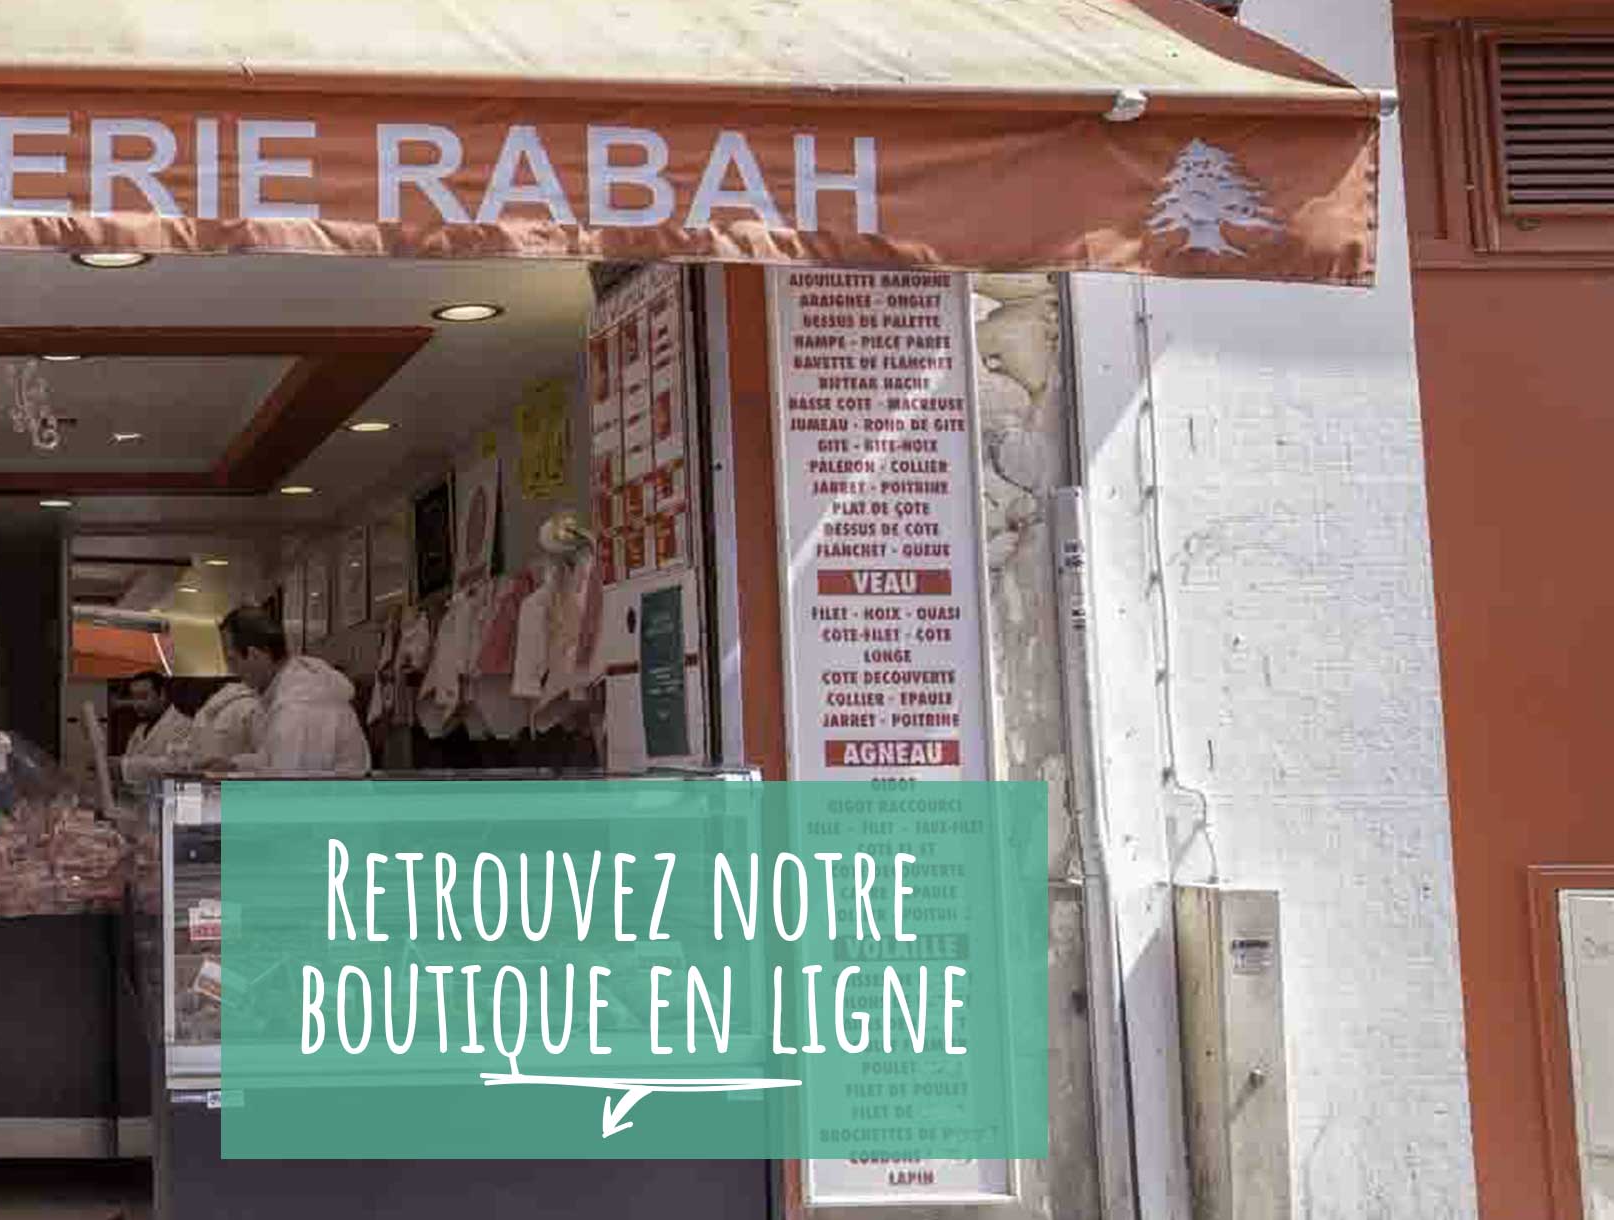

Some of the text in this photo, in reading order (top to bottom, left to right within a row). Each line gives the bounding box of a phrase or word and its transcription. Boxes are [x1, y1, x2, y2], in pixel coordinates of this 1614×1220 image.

[378, 122, 878, 234] RABAH
[887, 295, 941, 308] ONGLET
[803, 315, 941, 328] DESSUS DE PALETTE
[794, 336, 845, 349] HAMPE
[793, 356, 953, 370] BAVETTE DE FLANCHET
[789, 398, 964, 411] BASSE COTE MACREUSE
[790, 418, 966, 431] JUMEAU ROND DE GITE
[818, 440, 848, 452] GITE
[810, 460, 948, 473] PALERON COLLIER
[812, 481, 949, 495] JARRET POITRINE
[832, 502, 868, 515] PLAT
[871, 502, 889, 515] DE
[824, 523, 939, 536] DESSUS DE COTE
[816, 544, 950, 557] FLANCHET QUEUE
[853, 571, 917, 593] VEAU
[812, 606, 961, 621] FILET NOIX QUASI
[821, 628, 952, 642] COTE-FILET COTE
[864, 649, 912, 663] LONGE
[822, 671, 956, 684] COTE DECOUVERTE
[826, 692, 953, 706] COLLIER EPAULE
[823, 713, 960, 727] JARRET POITRINE
[843, 742, 943, 766] AGNEAU
[888, 1169, 934, 1185] LAPIN
